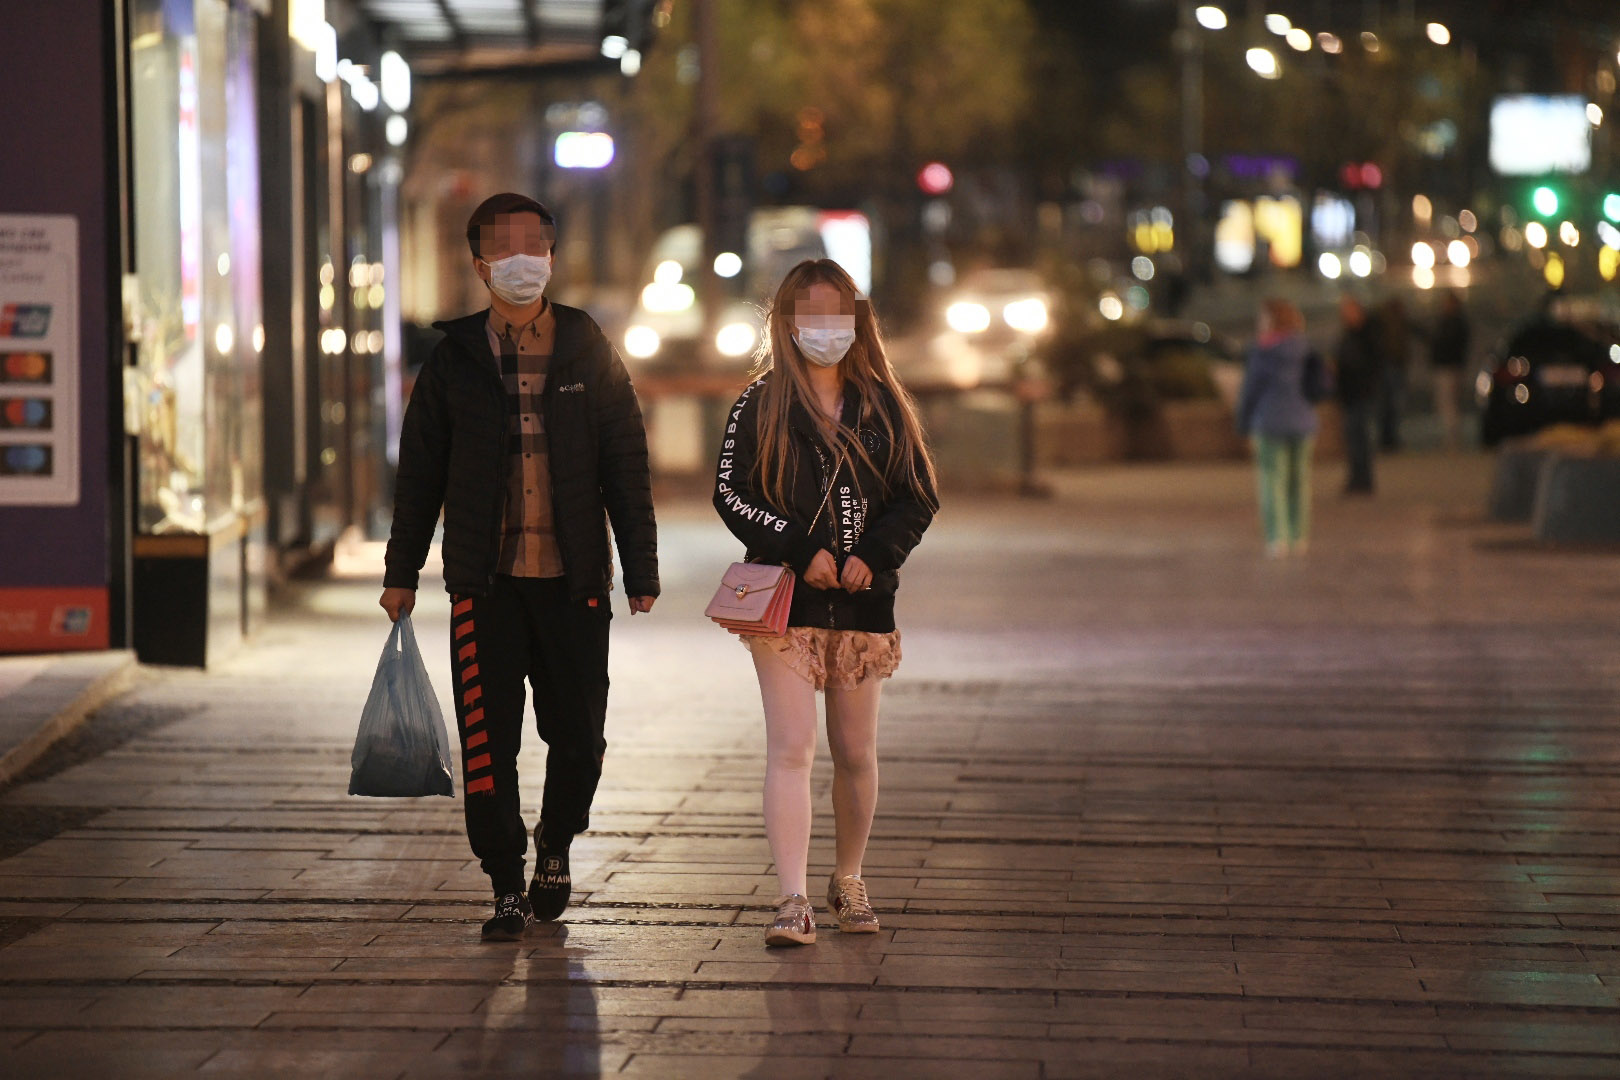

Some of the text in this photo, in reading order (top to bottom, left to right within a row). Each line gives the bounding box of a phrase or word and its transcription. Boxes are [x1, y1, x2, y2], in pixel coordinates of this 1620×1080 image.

[718, 439, 735, 494] PARIS
[839, 486, 852, 525] PARIS
[546, 858, 561, 871] B
